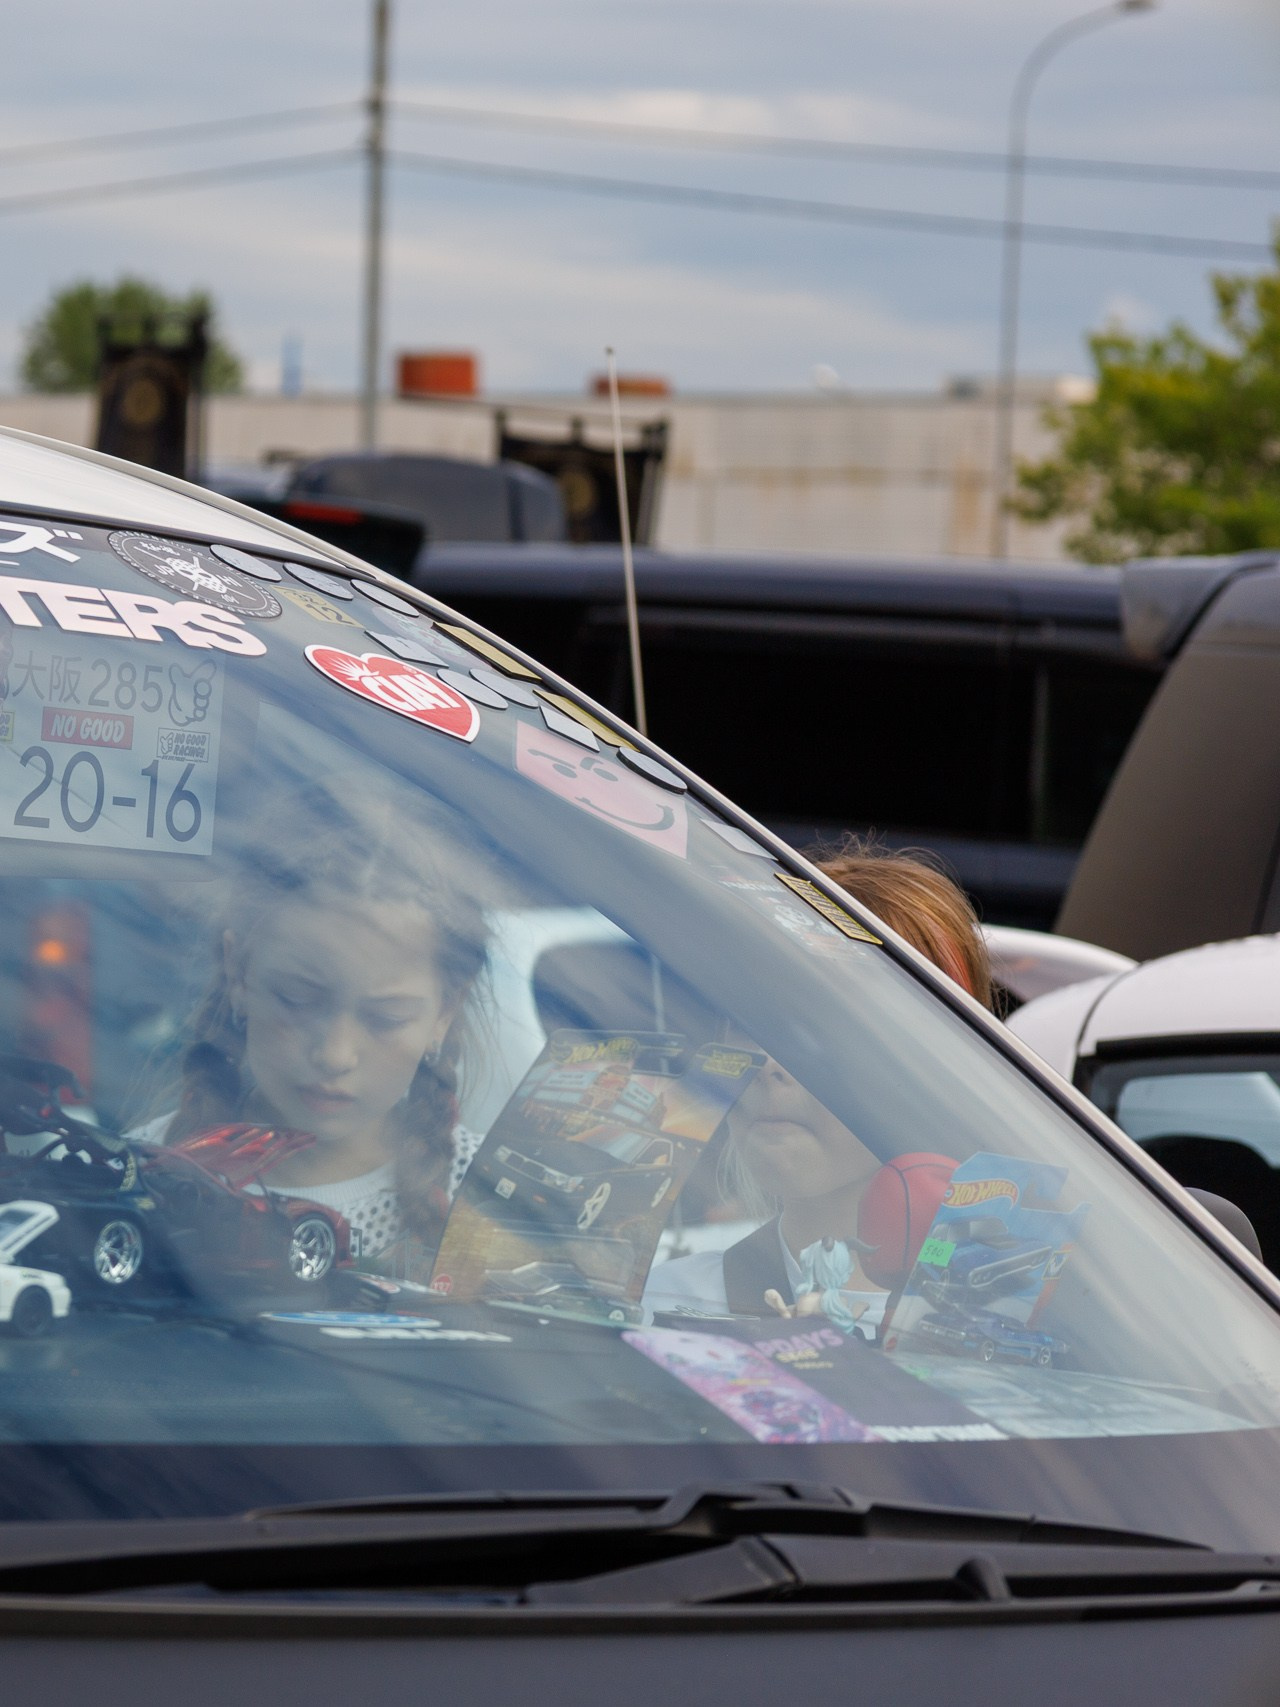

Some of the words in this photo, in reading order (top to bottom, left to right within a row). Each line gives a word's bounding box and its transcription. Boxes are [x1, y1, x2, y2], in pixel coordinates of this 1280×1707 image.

[12, 651, 82, 705] 大阪
[87, 657, 163, 714] 285
[50, 714, 77, 738] NO
[79, 717, 126, 744] GOOD
[13, 745, 203, 844] 20-16
